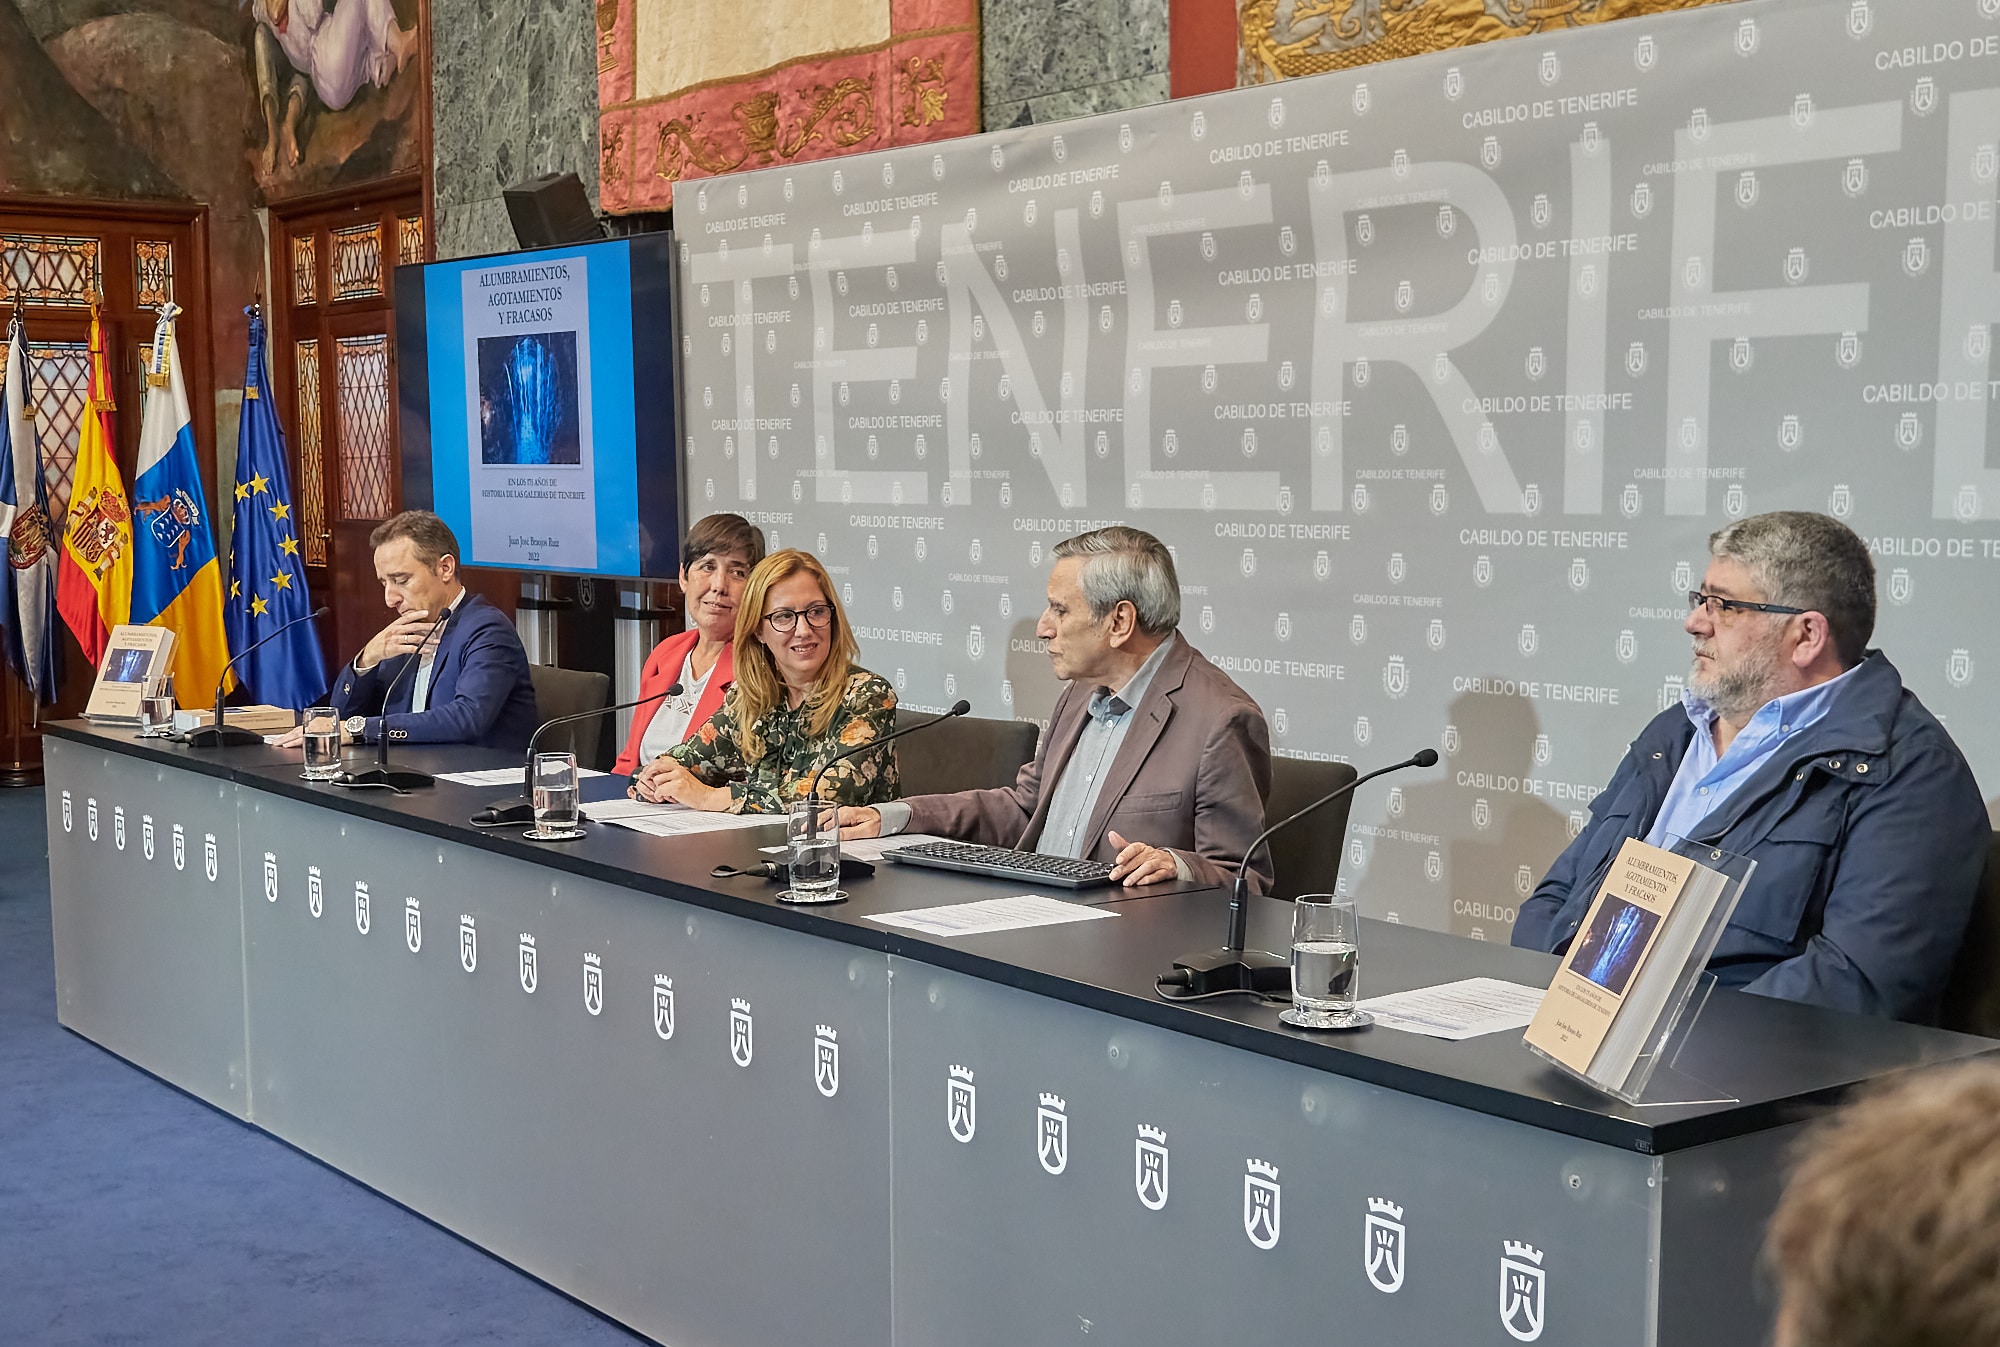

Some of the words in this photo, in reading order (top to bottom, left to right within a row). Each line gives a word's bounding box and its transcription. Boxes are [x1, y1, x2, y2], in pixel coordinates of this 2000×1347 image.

[1876, 41, 1963, 70] CABILDO
[1970, 36, 1998, 57] DE
[1463, 104, 1528, 129] CABILDO
[1533, 101, 1553, 118] DE
[1558, 88, 1637, 115] TENERIFE
[1210, 144, 1262, 164] CABILDO
[1265, 142, 1281, 156] DE
[1285, 130, 1348, 152] TENERIFE
[1009, 173, 1051, 193] CABILDO
[1052, 172, 1067, 187] DE
[1069, 164, 1119, 185] TENERIFE
[843, 199, 879, 217] CABILDO
[881, 199, 893, 213] DE
[894, 192, 938, 211] TENERIFE
[706, 218, 735, 234] CABILDO
[737, 217, 748, 230] DE
[750, 213, 786, 229] TENERIFE
[1870, 204, 1956, 229] CABILDO
[1963, 202, 1990, 220] DE
[1468, 244, 1531, 264] CABILDO
[1536, 242, 1556, 258] DE
[1561, 234, 1637, 256] TENERIFE
[480, 265, 570, 287] ALUMBRAMIENTOS,
[1219, 268, 1271, 286] CABILDO
[1274, 266, 1290, 280] DE
[1293, 259, 1356, 279] TENERIFE
[488, 287, 562, 306] AGOTAMIENTOS
[1013, 287, 1055, 302] CABILDO
[1057, 286, 1072, 299] DE
[1074, 281, 1126, 298] TENERIFE
[498, 313, 506, 324] Y
[507, 308, 552, 324] FRACASOS
[850, 303, 886, 317] CABILDO
[888, 302, 900, 314] DE
[902, 298, 943, 313] TENERIFE
[709, 314, 740, 328] CABILDO
[742, 313, 752, 325] DE
[753, 311, 790, 324] TENERIFE
[1863, 383, 1948, 403] CABILDO
[1955, 382, 1982, 400] DE
[1215, 404, 1265, 419] CABILDO
[1270, 404, 1285, 418] DE
[1289, 401, 1351, 417] TENERIFE
[1463, 397, 1526, 414] CABILDO
[1531, 396, 1550, 412] DE
[1555, 393, 1632, 410] TENERIFE
[712, 419, 744, 430] CABILDO
[744, 419, 754, 430] DE
[755, 418, 791, 430] TENERIFE
[849, 417, 883, 428] CABILDO
[886, 416, 898, 428] DE
[900, 415, 942, 428] TENERIFE
[1012, 411, 1053, 424] CABILDO
[1056, 410, 1070, 423] DE
[1072, 408, 1123, 422] TENERIFE
[1356, 469, 1390, 479] CABILDO
[1392, 470, 1402, 479] DE
[1404, 469, 1445, 479] TENERIFE
[1634, 468, 1676, 478] CABILDO
[1679, 468, 1693, 478] DE
[1696, 468, 1745, 478] TENERIFE
[758, 511, 792, 524] TENERIFE
[850, 515, 886, 528] CABILDO
[888, 516, 900, 528] DE
[902, 516, 944, 530] TENERIFE
[1013, 518, 1055, 532] CABILDO
[1058, 520, 1071, 532] DE
[1215, 523, 1265, 538] CABILDO
[1269, 524, 1285, 538] DE
[1289, 524, 1350, 540] TENERIFE
[1460, 529, 1522, 545] CABILDO
[1528, 531, 1547, 546] DE
[1552, 531, 1627, 548] TENERIFE
[1948, 539, 1973, 557] DE
[1353, 594, 1387, 604] CABILDO
[1390, 595, 1399, 605] DE
[1401, 596, 1442, 607] TENERIFE
[1629, 607, 1671, 619] CABILDO
[1674, 608, 1688, 620] DE
[887, 628, 898, 642] DE
[901, 629, 942, 646] TENERIFE
[1264, 659, 1281, 674] DE
[1285, 661, 1345, 680] TENERIFE
[1453, 677, 1515, 695] CABILDO
[1520, 681, 1539, 697] DE
[1544, 683, 1619, 704] TENERIFE
[1456, 771, 1519, 792] CABILDO
[1523, 776, 1542, 797] DE
[1352, 824, 1384, 836] CABILDO
[1388, 826, 1399, 838] DE
[1401, 828, 1439, 845] TENERIFE
[1453, 899, 1515, 923] CABILDO
